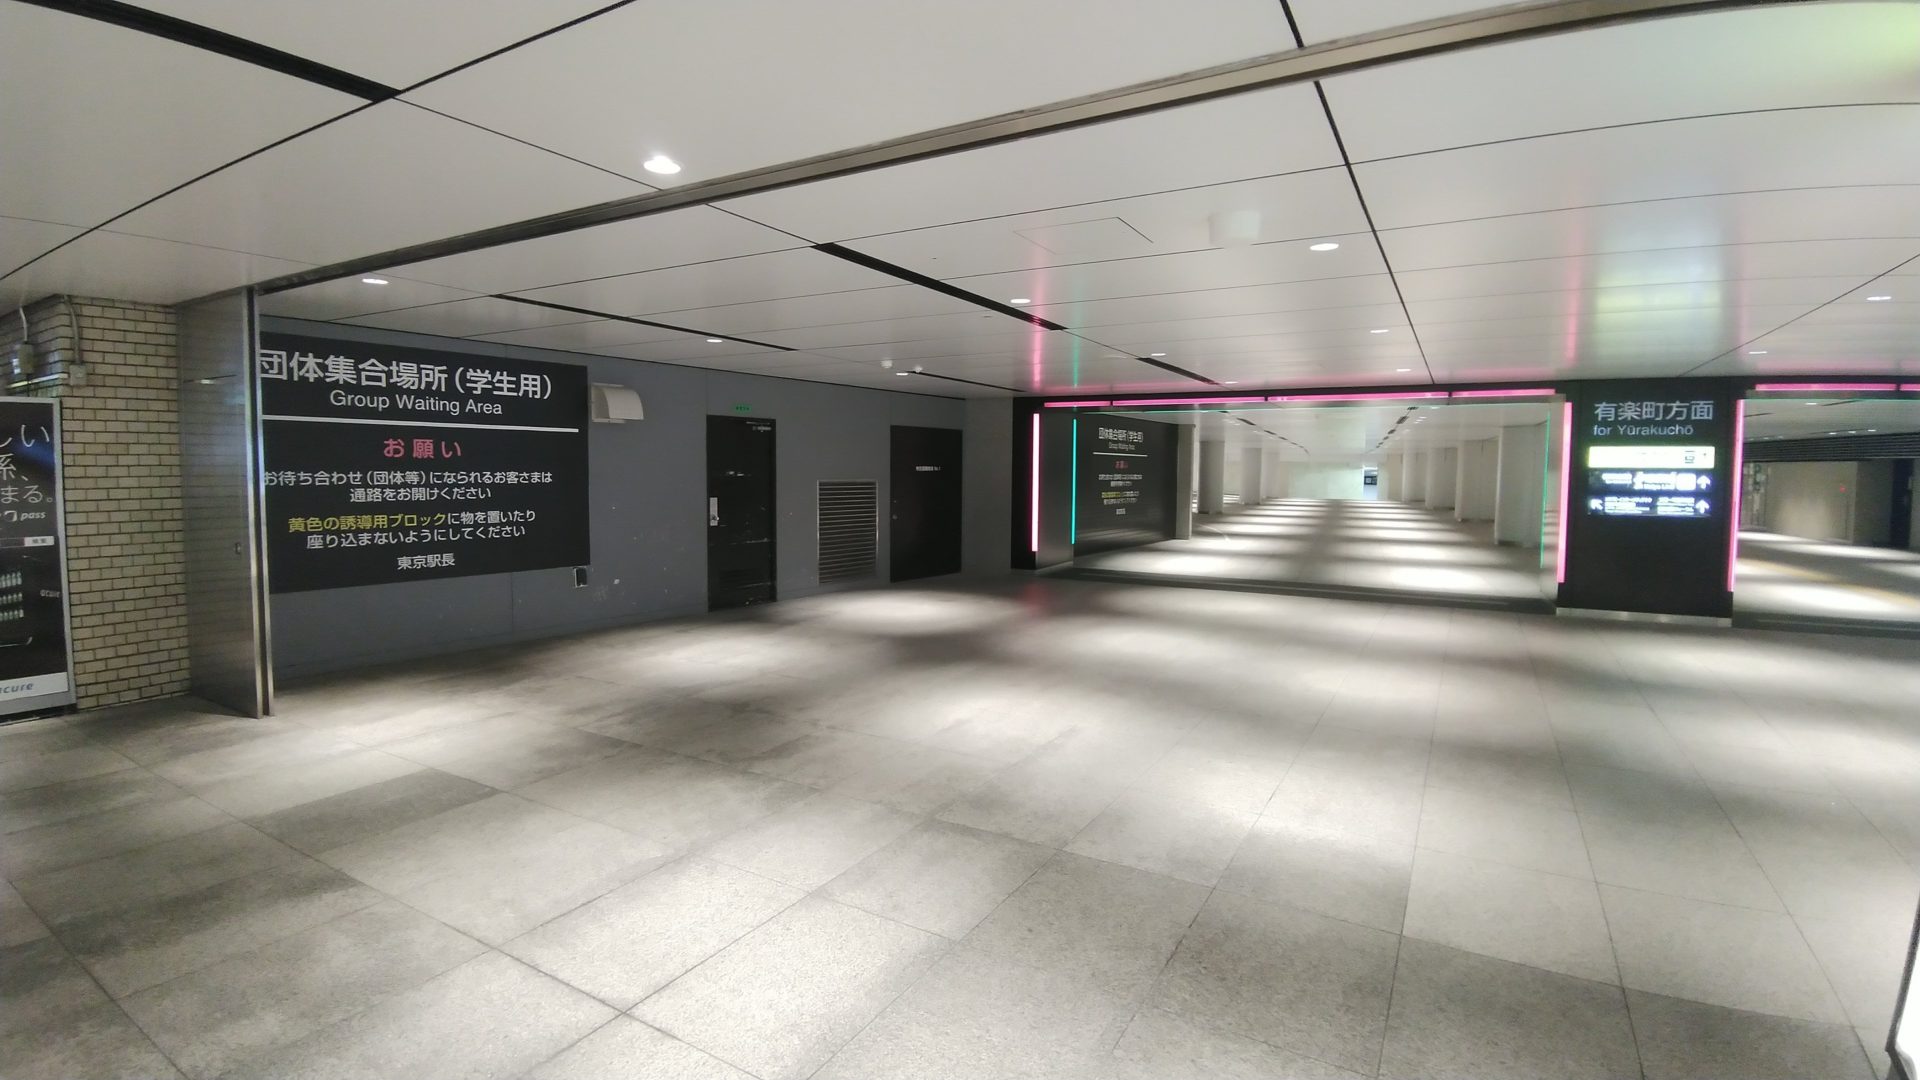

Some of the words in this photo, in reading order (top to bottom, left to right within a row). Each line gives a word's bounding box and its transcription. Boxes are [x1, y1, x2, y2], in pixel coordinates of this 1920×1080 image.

[259, 350, 552, 399] 団体集合場所(学生用)
[329, 388, 390, 411] Group
[395, 394, 461, 416] Waiting
[465, 397, 503, 416] Area
[1594, 400, 1714, 422] 有楽町方面
[1593, 424, 1612, 436] for
[383, 438, 462, 460] お願い
[349, 487, 492, 503] 通路をお開けください
[288, 509, 537, 534] 黄色の誘導用ブロックに物を置いたり
[306, 525, 526, 550] 座り込まないようにしてください
[397, 552, 455, 571] 東京駅長
